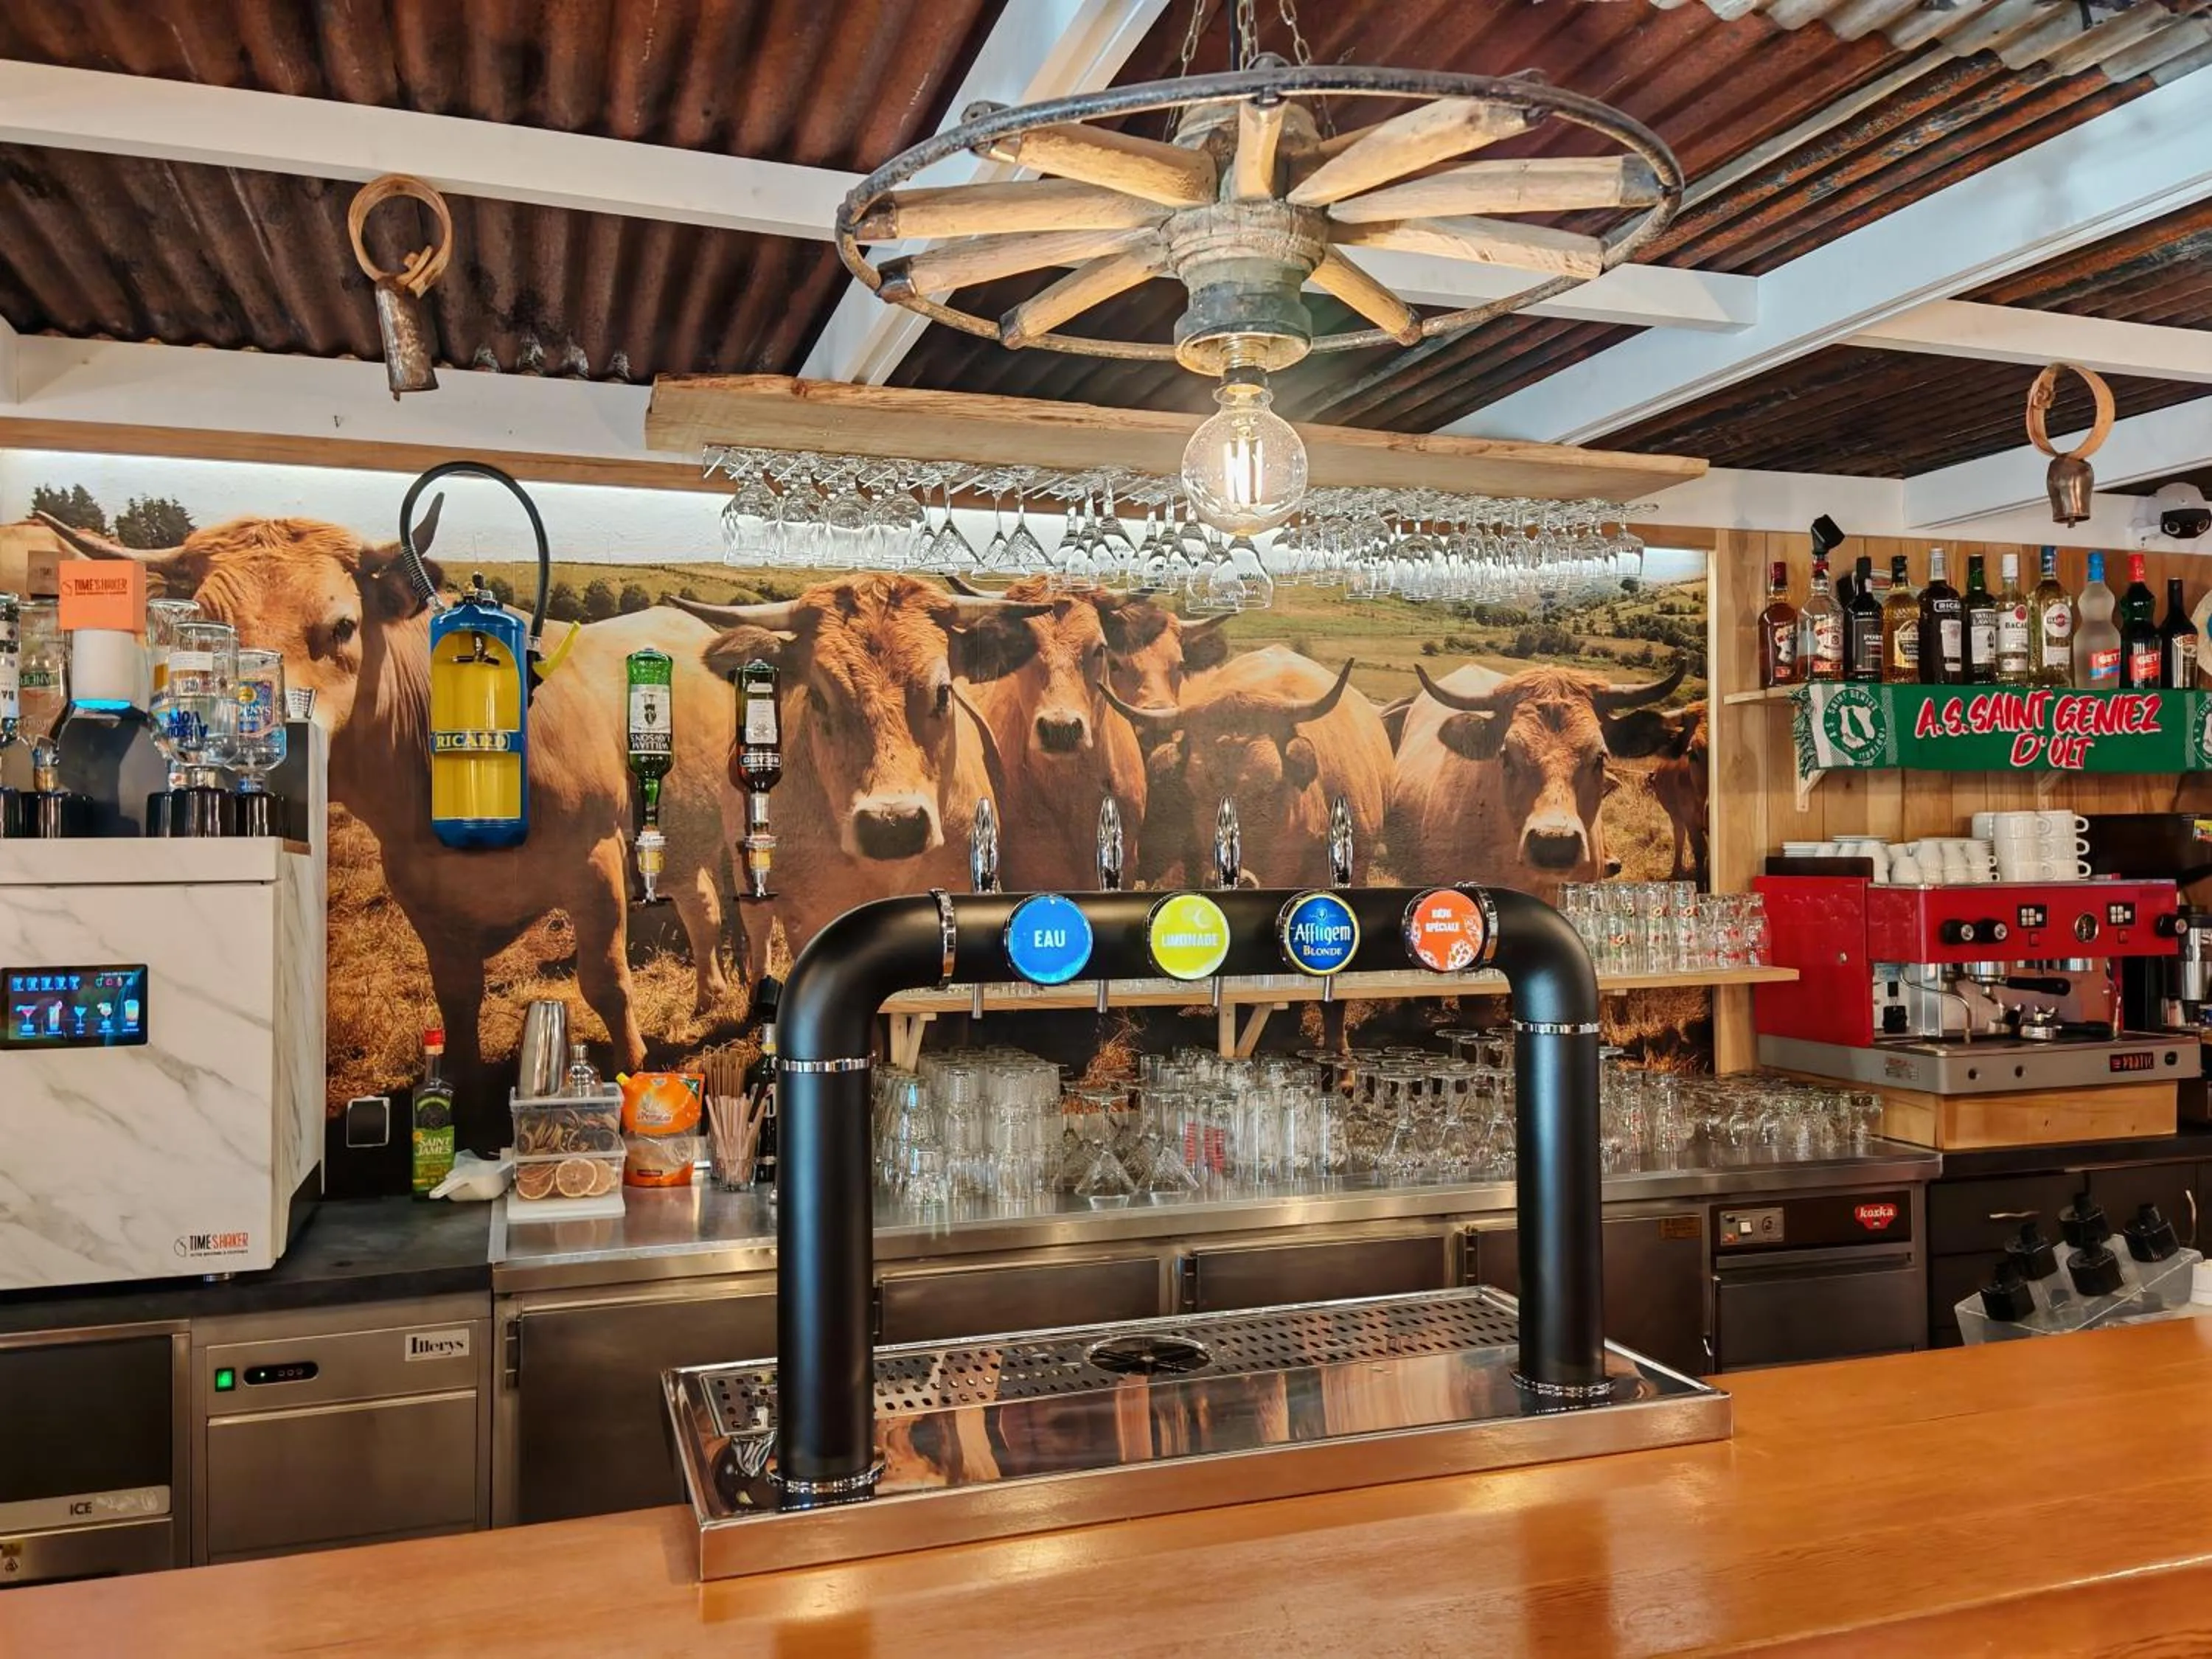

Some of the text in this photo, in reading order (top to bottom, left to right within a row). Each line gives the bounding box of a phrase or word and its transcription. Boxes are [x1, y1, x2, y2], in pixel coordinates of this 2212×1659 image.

[2053, 693, 2162, 736] GENIEZ
[435, 734, 507, 748] RICARD
[742, 756, 779, 764] RICARD
[1034, 929, 1066, 948] EAU
[1292, 922, 1352, 945] Affligem
[70, 1501, 93, 1516] ICE
